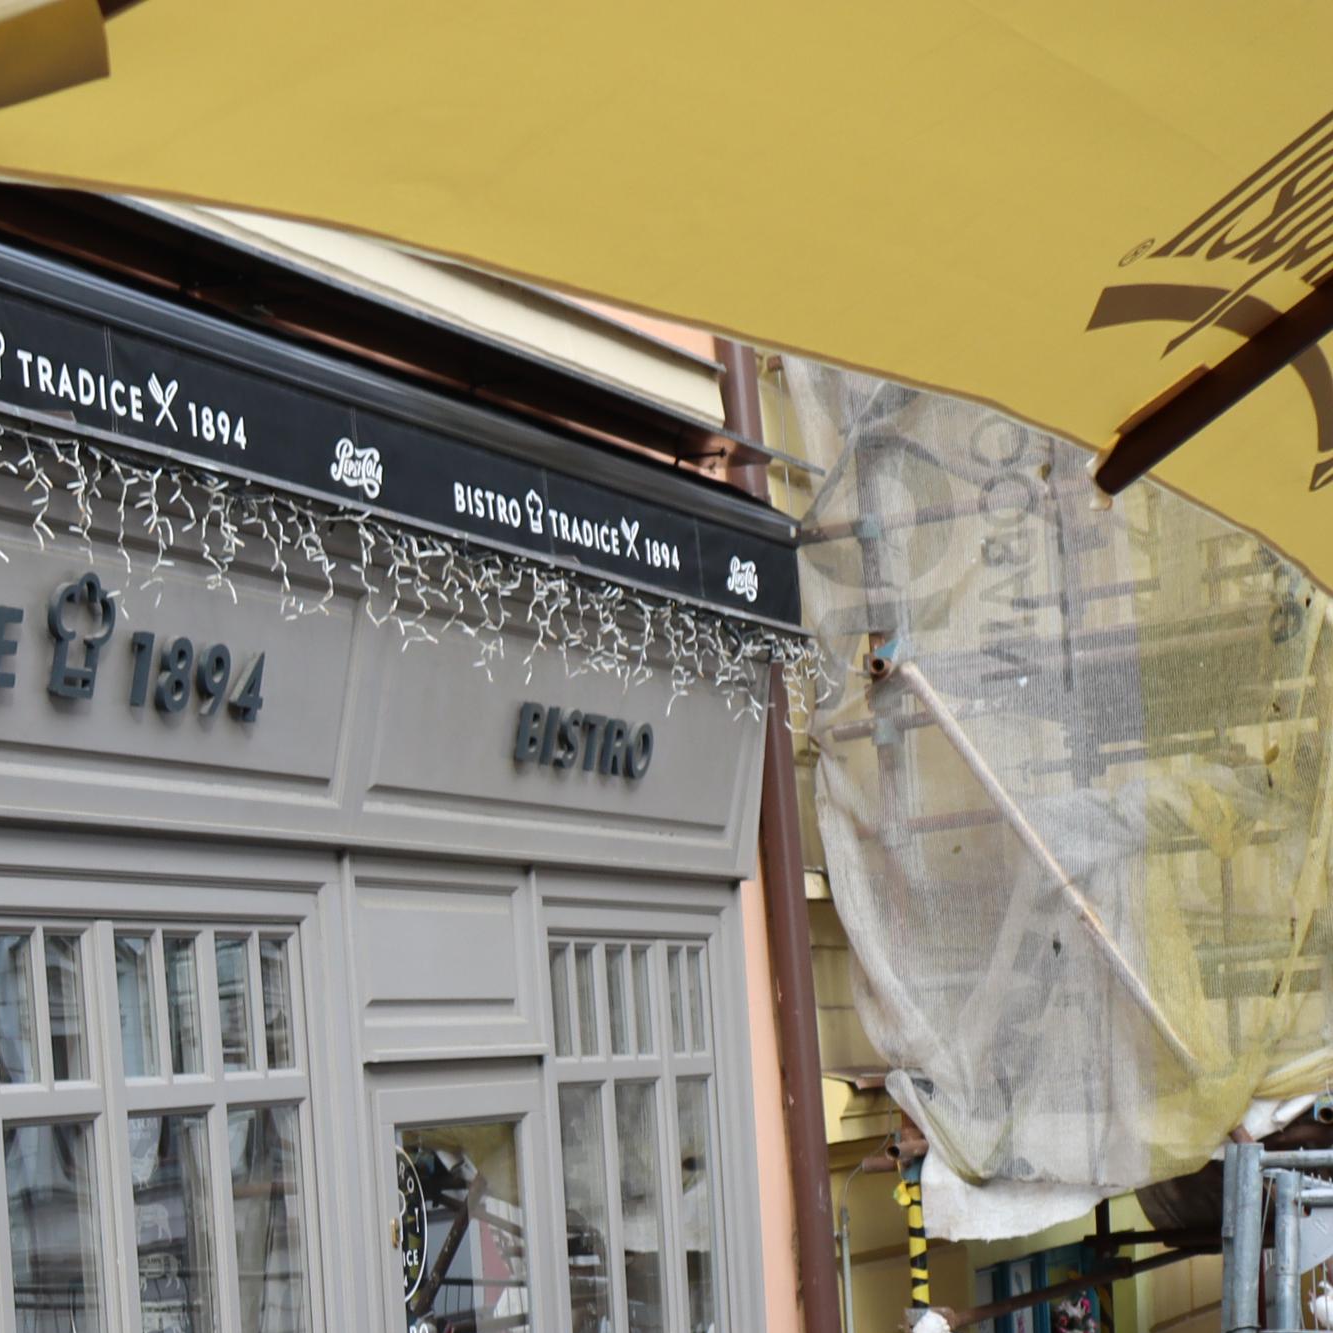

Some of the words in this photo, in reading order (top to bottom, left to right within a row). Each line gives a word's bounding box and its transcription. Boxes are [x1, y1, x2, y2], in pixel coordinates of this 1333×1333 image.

[17, 350, 144, 423] TRADICE
[187, 401, 248, 450] 1894
[453, 482, 521, 529] BISTRO
[548, 509, 620, 554] TRADICE
[644, 537, 681, 572] 1894
[130, 630, 267, 723] 1894
[514, 701, 654, 780] BISTRO
